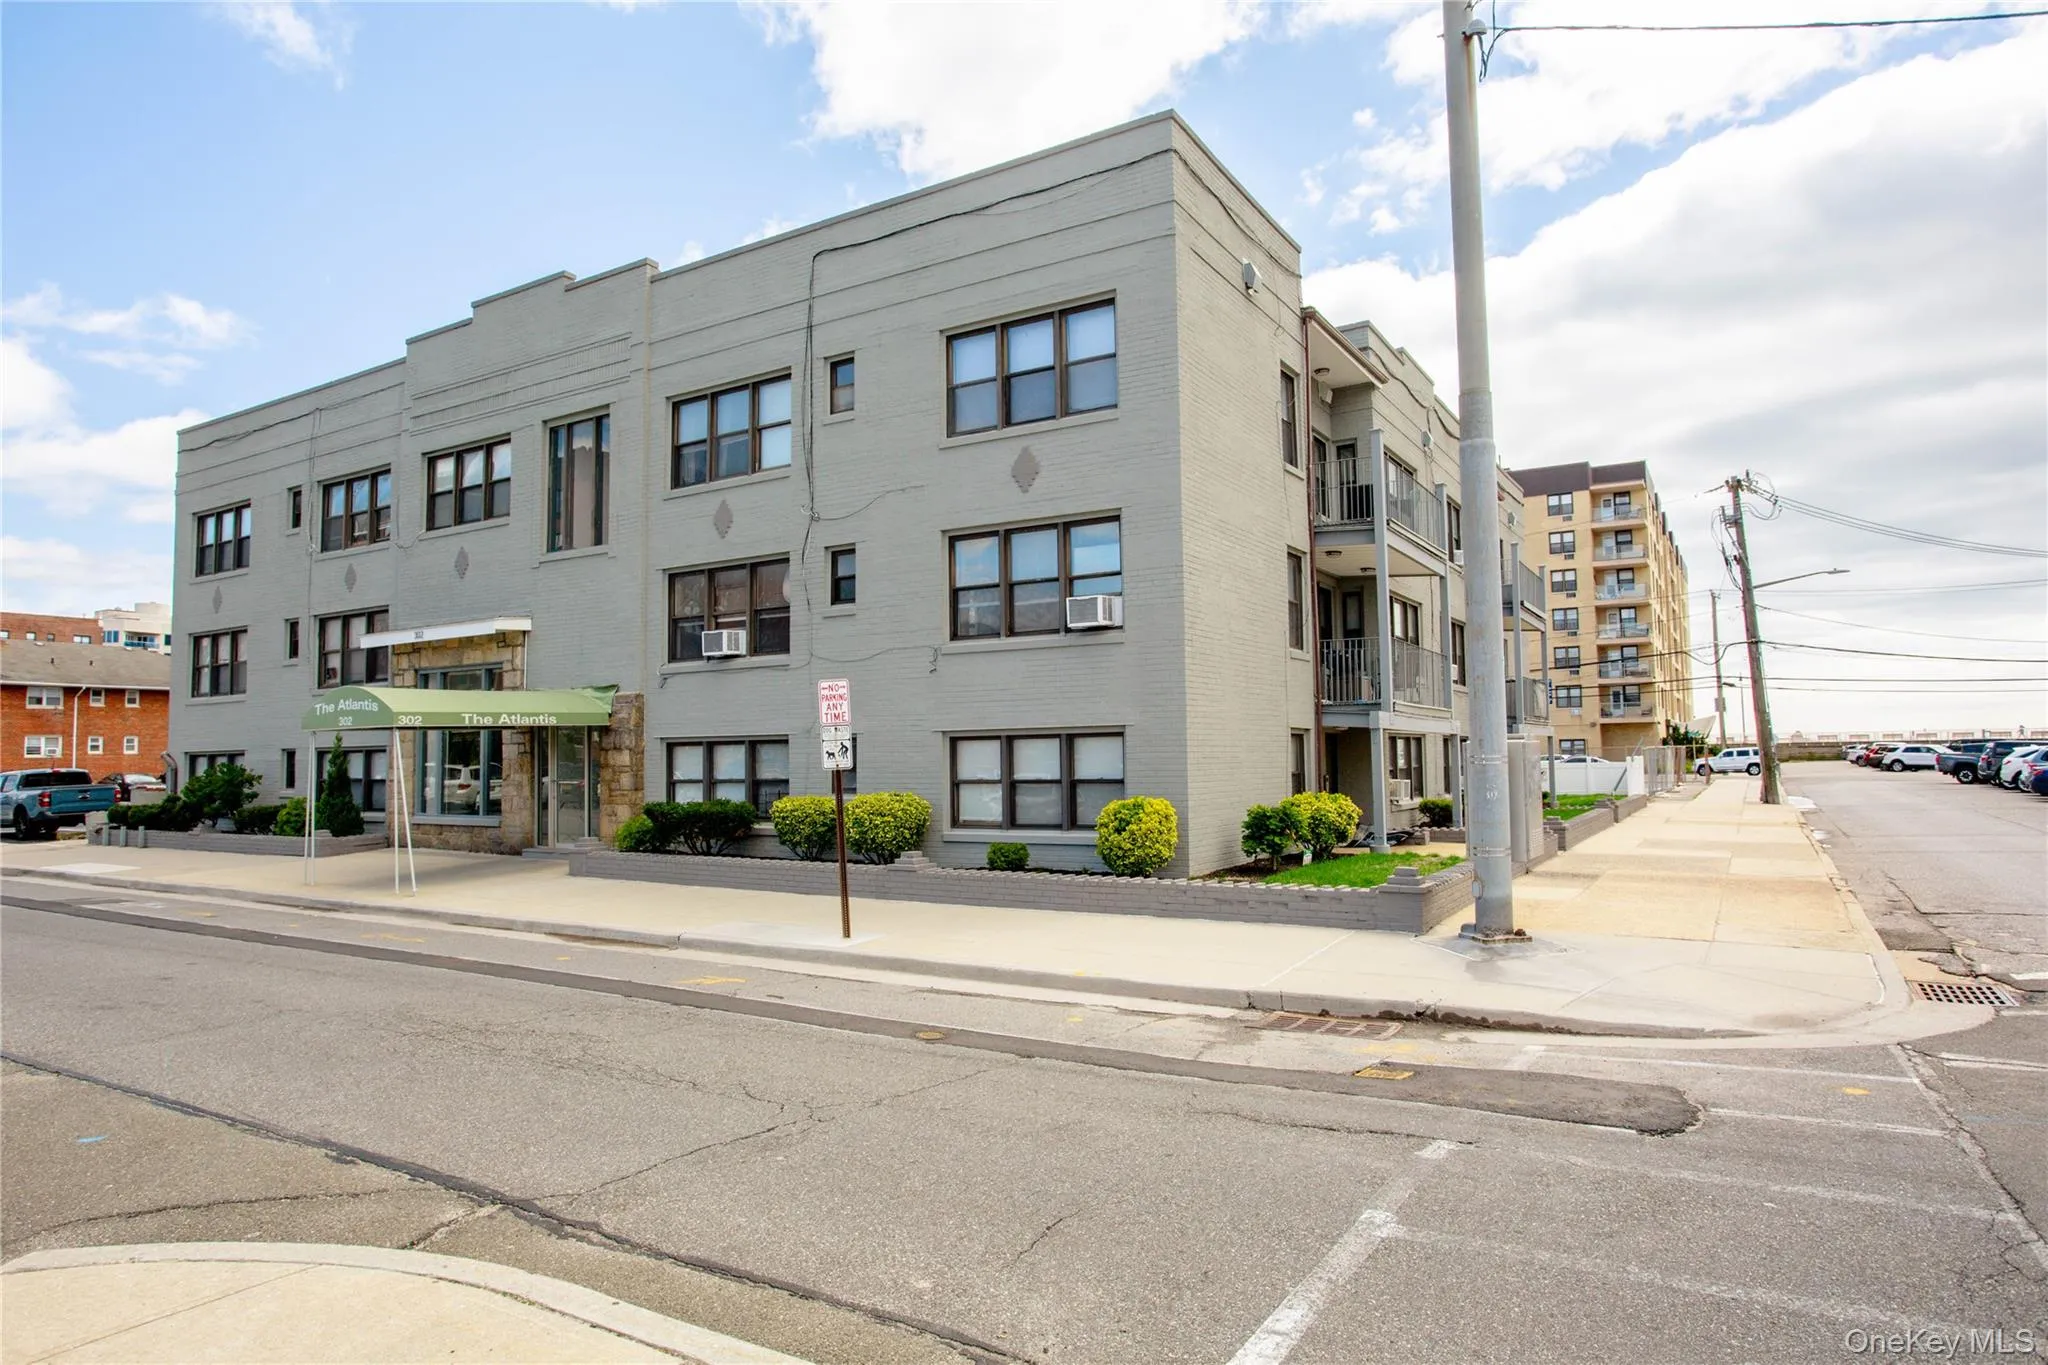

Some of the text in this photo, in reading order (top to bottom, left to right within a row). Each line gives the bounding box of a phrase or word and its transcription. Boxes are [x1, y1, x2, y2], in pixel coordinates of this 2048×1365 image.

[828, 684, 840, 692] NO
[821, 694, 848, 702] PARKING
[315, 698, 379, 716] The Atlantis
[826, 703, 843, 711] ANY
[338, 716, 353, 726] 302
[397, 715, 423, 726] 302
[461, 713, 557, 725] The Atlantis
[824, 712, 847, 722] TIME
